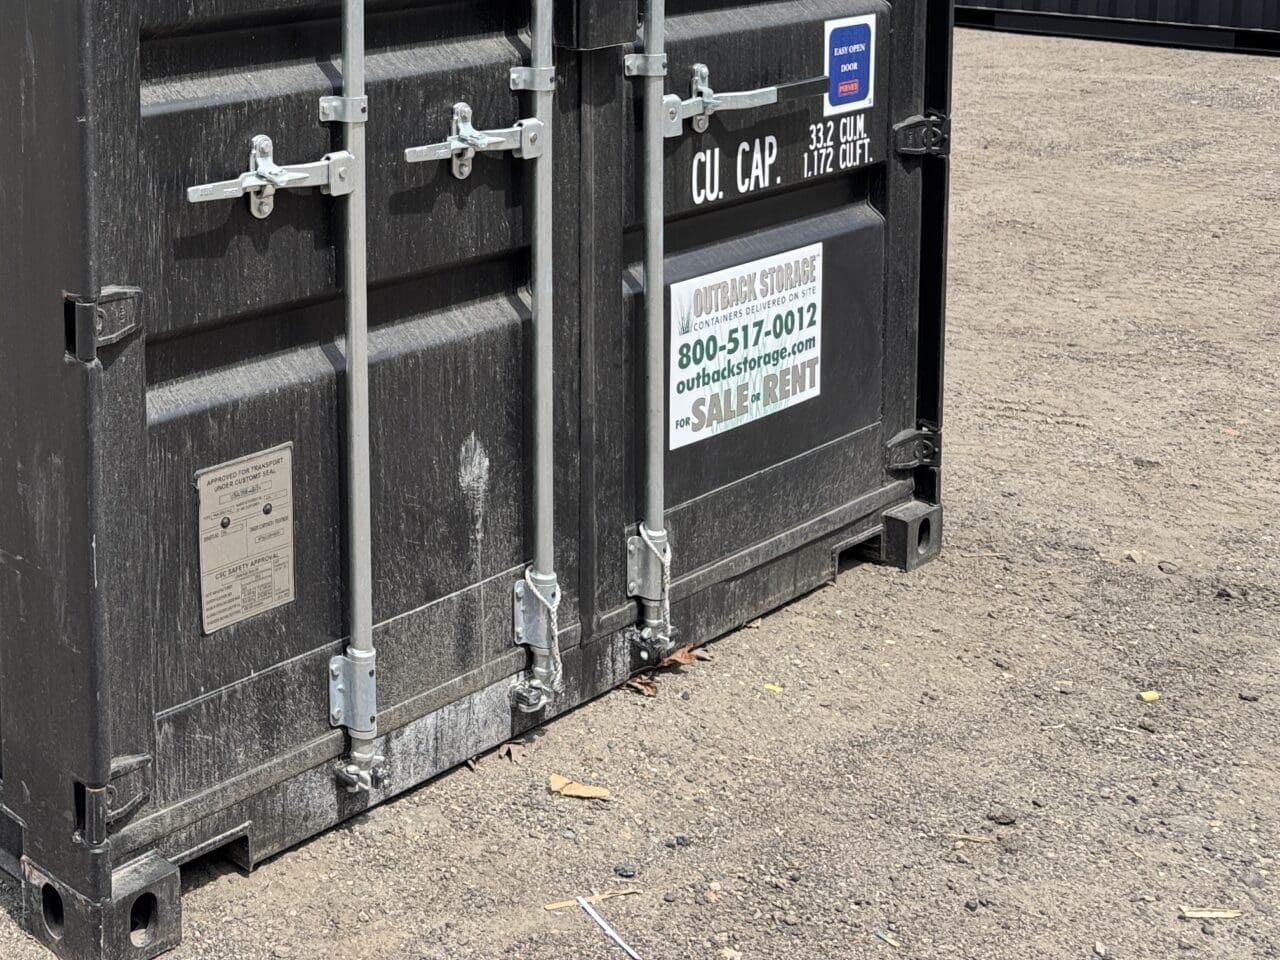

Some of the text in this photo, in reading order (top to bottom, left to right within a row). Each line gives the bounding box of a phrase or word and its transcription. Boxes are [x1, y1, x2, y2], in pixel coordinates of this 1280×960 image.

[834, 43, 866, 56] EASY OPEN
[840, 62, 858, 73] DOOR
[692, 147, 723, 204] CU.
[737, 135, 781, 193] CAP.
[809, 121, 834, 150] 33.2
[693, 255, 817, 318] OUTBACK STORAGE
[693, 287, 817, 331] CONTAINERS DELIVERED ON SITE
[678, 302, 817, 369] 800-517-0012
[676, 336, 816, 394] outbackstorage.com
[675, 357, 819, 432] FOR SALE OR RENT
[206, 457, 284, 486] APPROVED FOR TRANSPORT
[213, 482, 234, 492] UNDER
[234, 474, 261, 486] CUSTOMS
[262, 468, 277, 476] SEAL
[228, 563, 249, 575] SAFETY
[250, 553, 280, 567] APPROVAL
